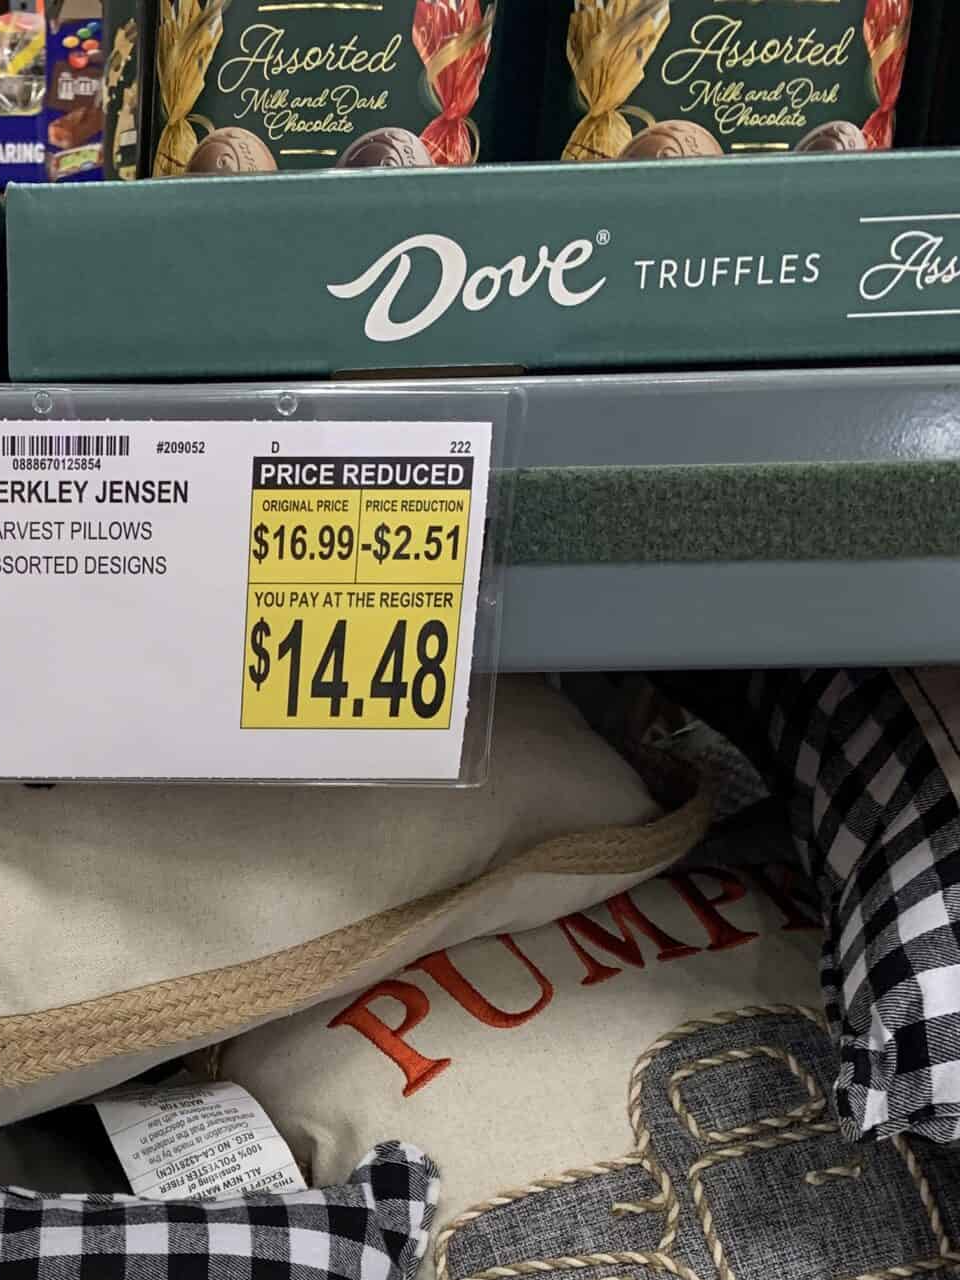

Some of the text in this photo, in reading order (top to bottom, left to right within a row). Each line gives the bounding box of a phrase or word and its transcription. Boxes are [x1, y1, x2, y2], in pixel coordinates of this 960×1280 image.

[217, 23, 402, 93] Assorted
[661, 14, 855, 85] Assorted
[234, 85, 389, 119] Milk and Dark
[680, 78, 839, 112] Milk and Dark
[263, 109, 354, 140] Chocolate
[714, 102, 807, 134] Chocolate
[327, 233, 606, 342] Dove
[634, 252, 821, 291] TRUFFLES
[156, 441, 472, 454] #209052 D 222
[12, 458, 101, 471] 0888670125854
[260, 463, 464, 485] PRICE REDUCED
[95, 480, 189, 503] JENSEN
[262, 500, 349, 512] ORIGINAL PRICE
[365, 500, 463, 512] PRICE REDUCTION
[70, 521, 153, 540] PILLOWS
[252, 522, 354, 564] $16.99
[360, 522, 461, 564] -$2.51
[85, 556, 167, 574] DESIGNS
[255, 591, 453, 608] YOU PAY AT THE REGISTER
[248, 616, 449, 719] $14.48
[185, 1152, 237, 1183] POLYESTER
[158, 1176, 186, 1194] FIBER
